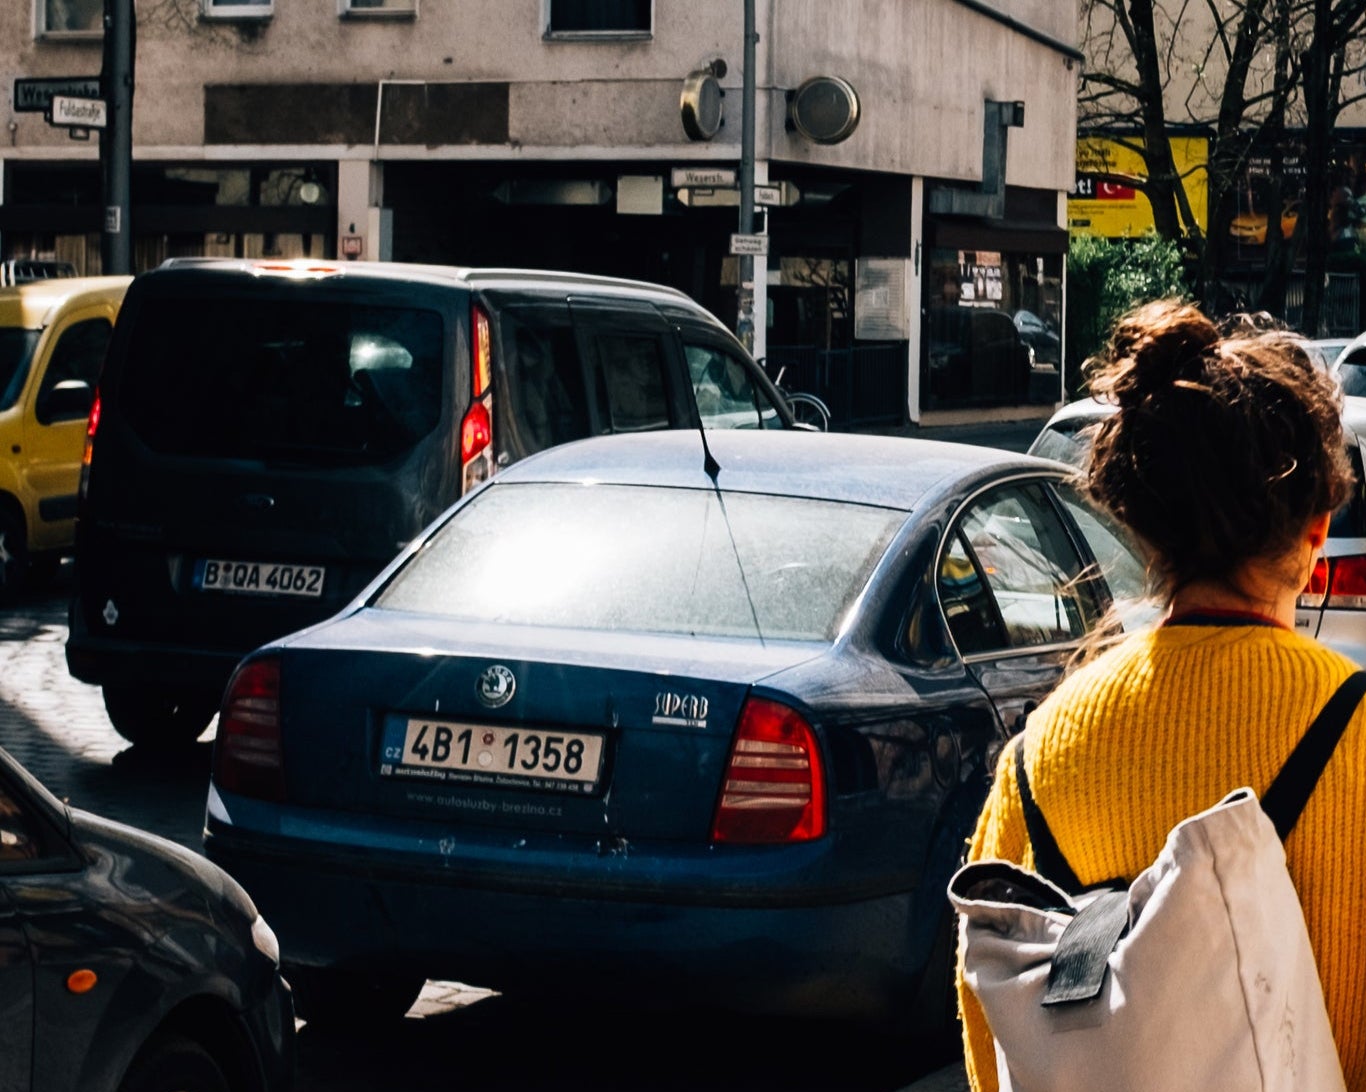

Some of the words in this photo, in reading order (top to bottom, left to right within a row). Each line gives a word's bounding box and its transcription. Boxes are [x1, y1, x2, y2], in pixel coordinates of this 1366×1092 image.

[204, 562, 220, 586] B
[232, 564, 261, 589] QA
[265, 566, 322, 593] 4062
[385, 747, 400, 759] CZ
[410, 725, 472, 764] 4B1
[503, 732, 585, 774] 1358
